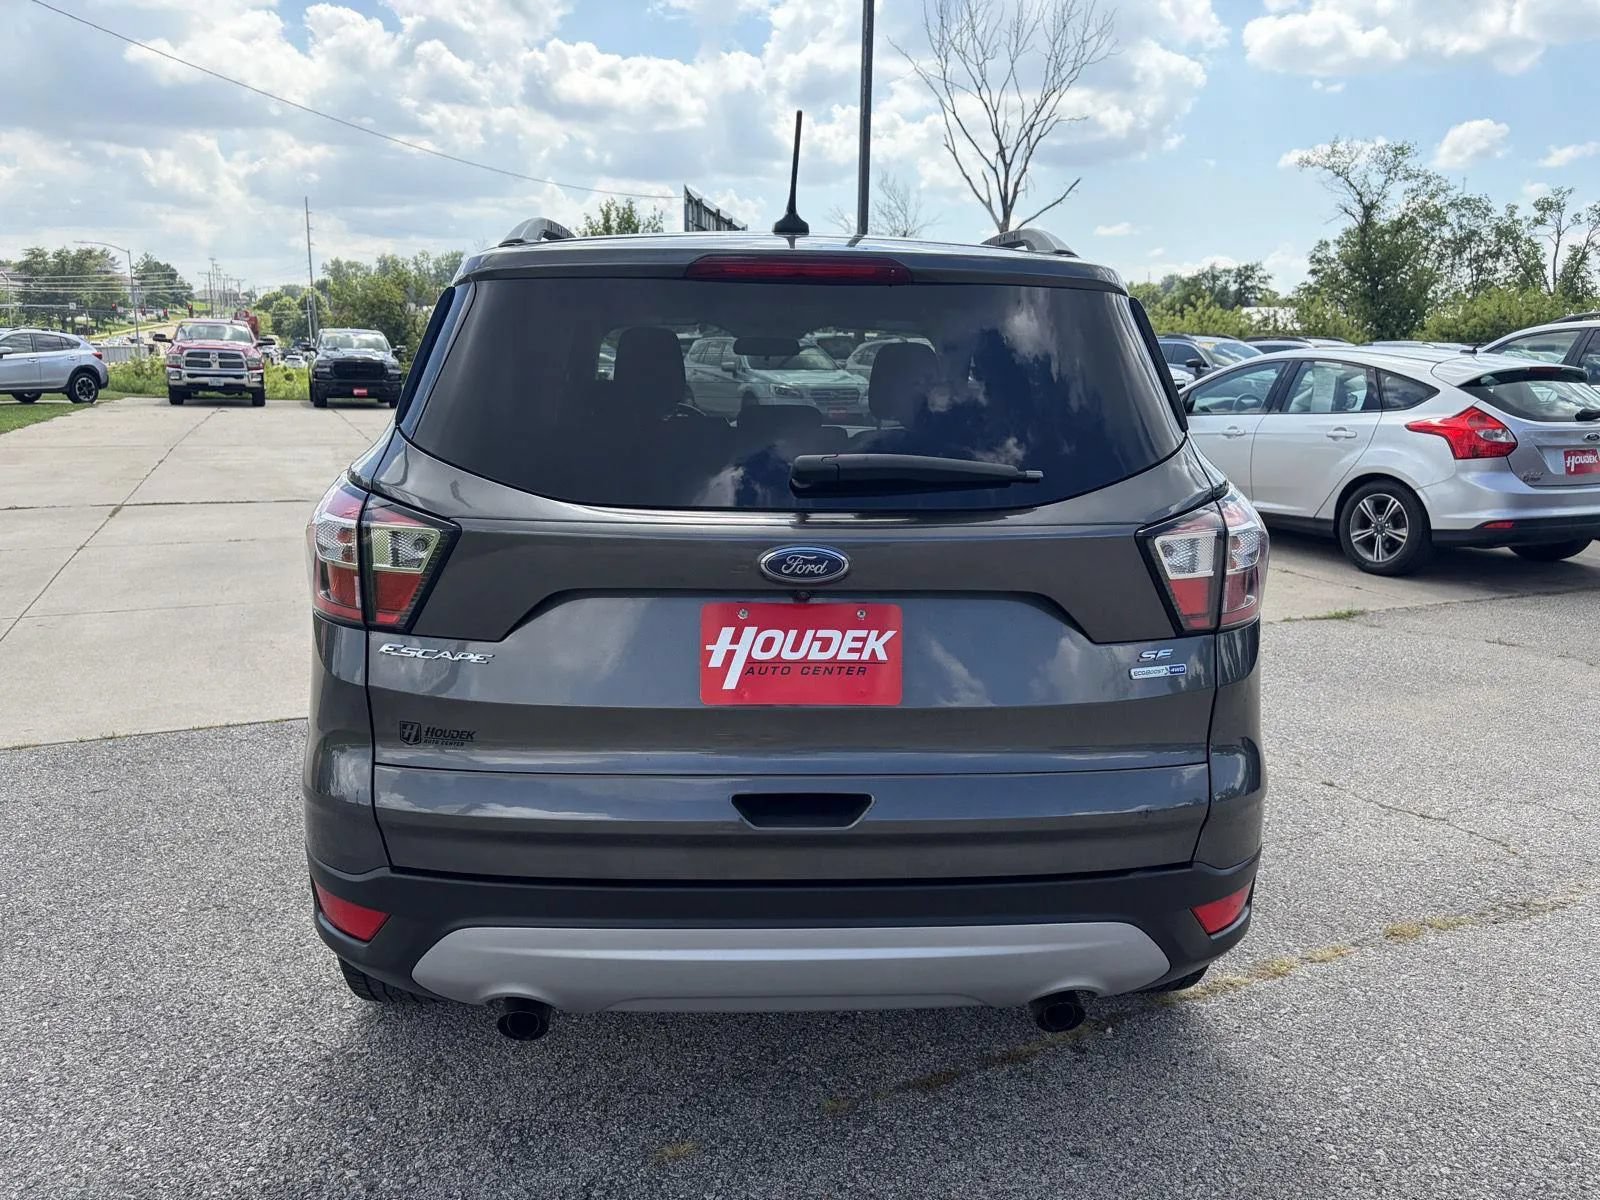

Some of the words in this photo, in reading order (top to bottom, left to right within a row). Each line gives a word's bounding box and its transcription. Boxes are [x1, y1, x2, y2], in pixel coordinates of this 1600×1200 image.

[781, 553, 828, 575] Ford
[379, 643, 495, 665] ESCAPE
[705, 626, 897, 690] HOUDEK
[744, 666, 791, 676] AUTO
[800, 666, 868, 676] CENTER
[1169, 666, 1185, 674] 4WD
[424, 727, 476, 740] HOUDEK
